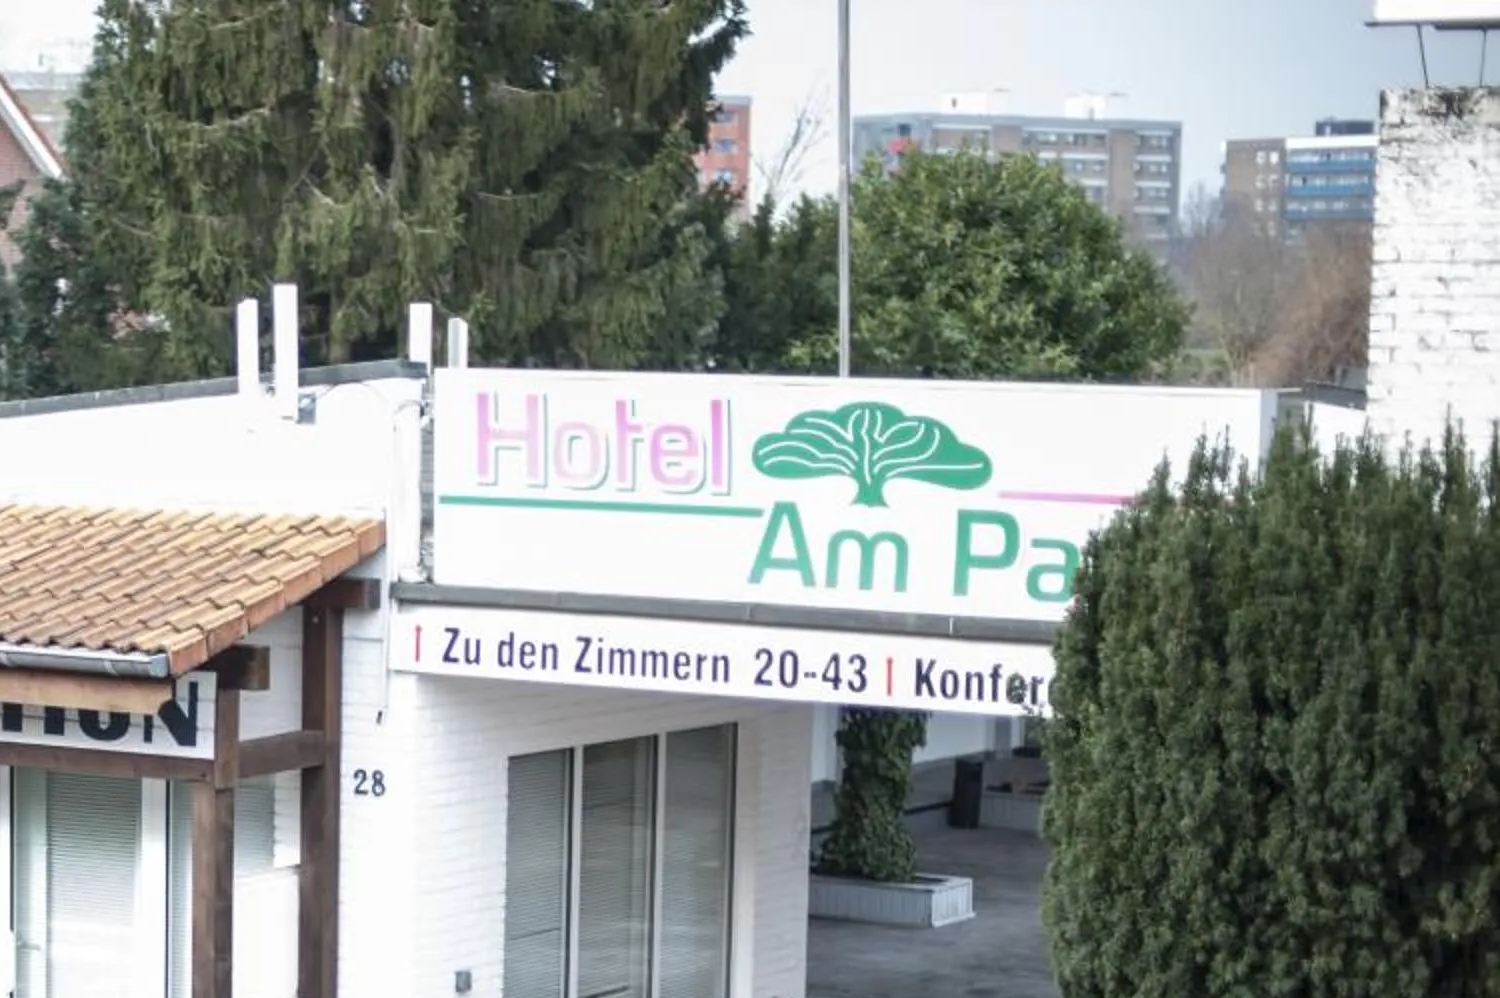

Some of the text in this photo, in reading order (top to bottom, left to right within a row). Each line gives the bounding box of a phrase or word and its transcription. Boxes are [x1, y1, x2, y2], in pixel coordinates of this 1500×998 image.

[476, 391, 733, 496] Hotel
[747, 501, 909, 593] Am
[442, 627, 481, 665] Zu
[497, 631, 559, 671] den
[574, 636, 731, 683] Zimmern
[915, 658, 1056, 706] Konfer
[353, 768, 386, 797] 28
